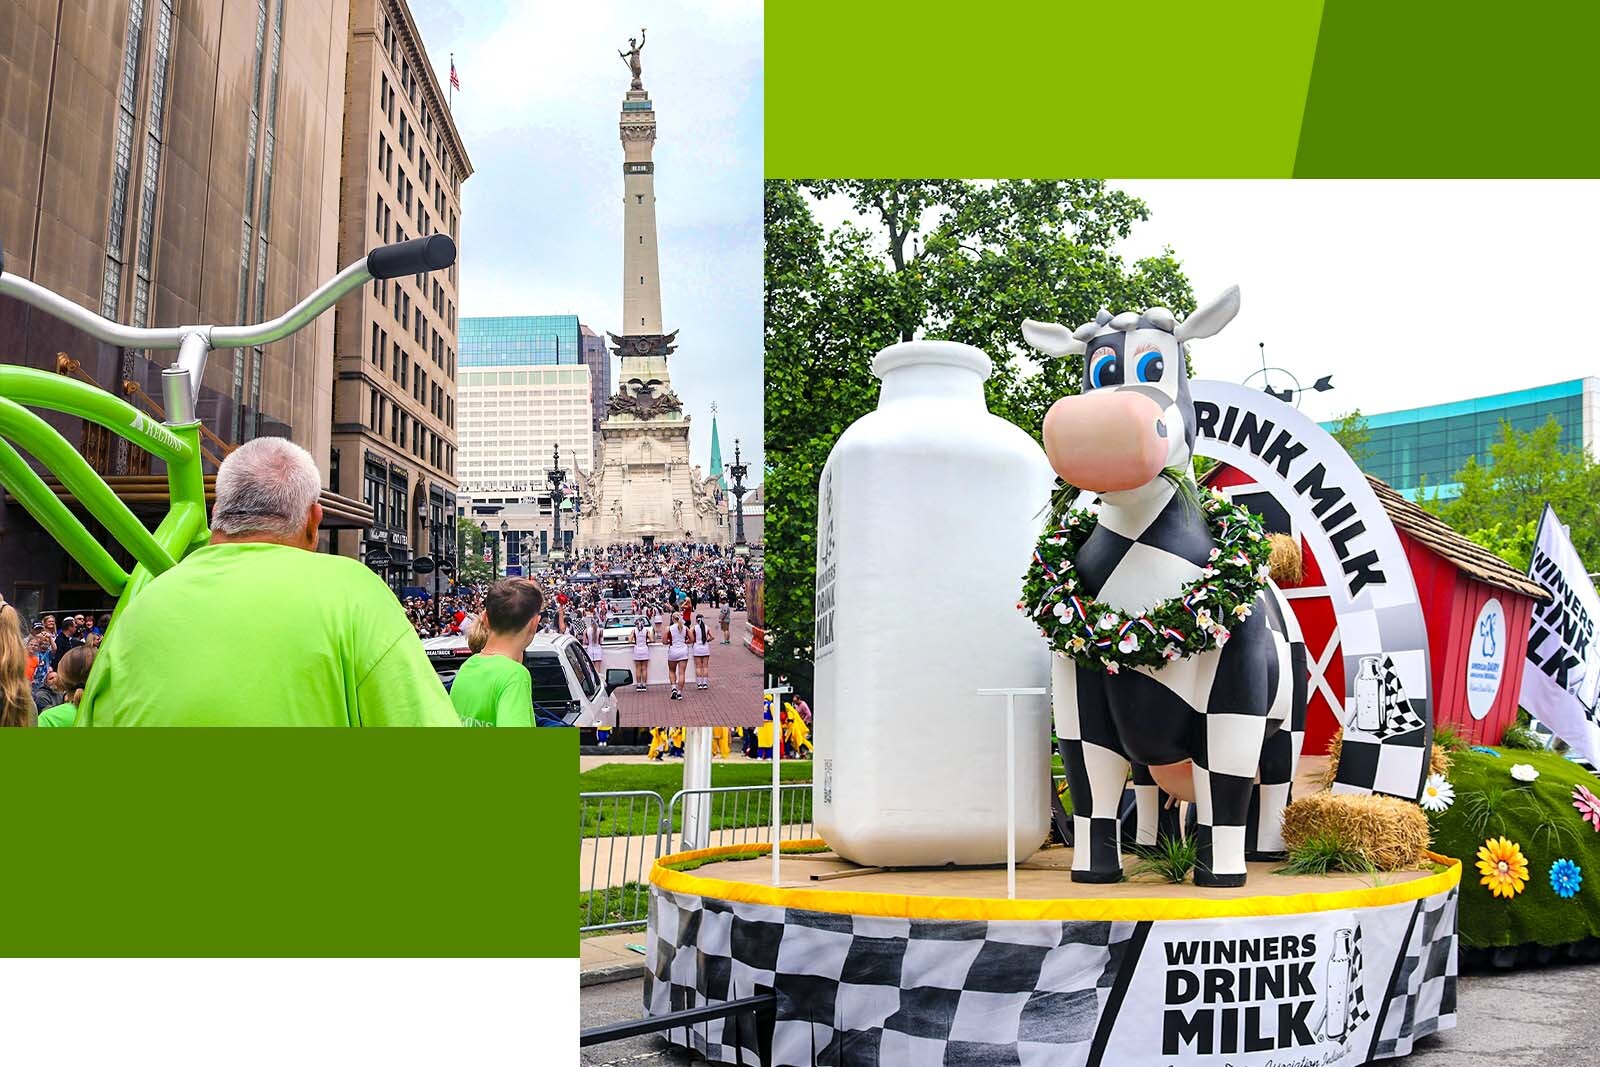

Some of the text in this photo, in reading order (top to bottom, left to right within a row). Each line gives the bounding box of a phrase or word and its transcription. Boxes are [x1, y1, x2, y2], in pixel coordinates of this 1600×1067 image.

[145, 421, 182, 452] REGIONS
[1193, 400, 1387, 599] RINK MILK
[816, 581, 836, 618] DRINK
[1534, 546, 1594, 638] WINNERS
[815, 609, 835, 650] MILK
[1530, 573, 1590, 662] RINK
[1526, 617, 1580, 691] LK
[1164, 933, 1317, 966] WINNERS
[1164, 961, 1317, 1006] DRINK
[1162, 1001, 1317, 1056] MILK
